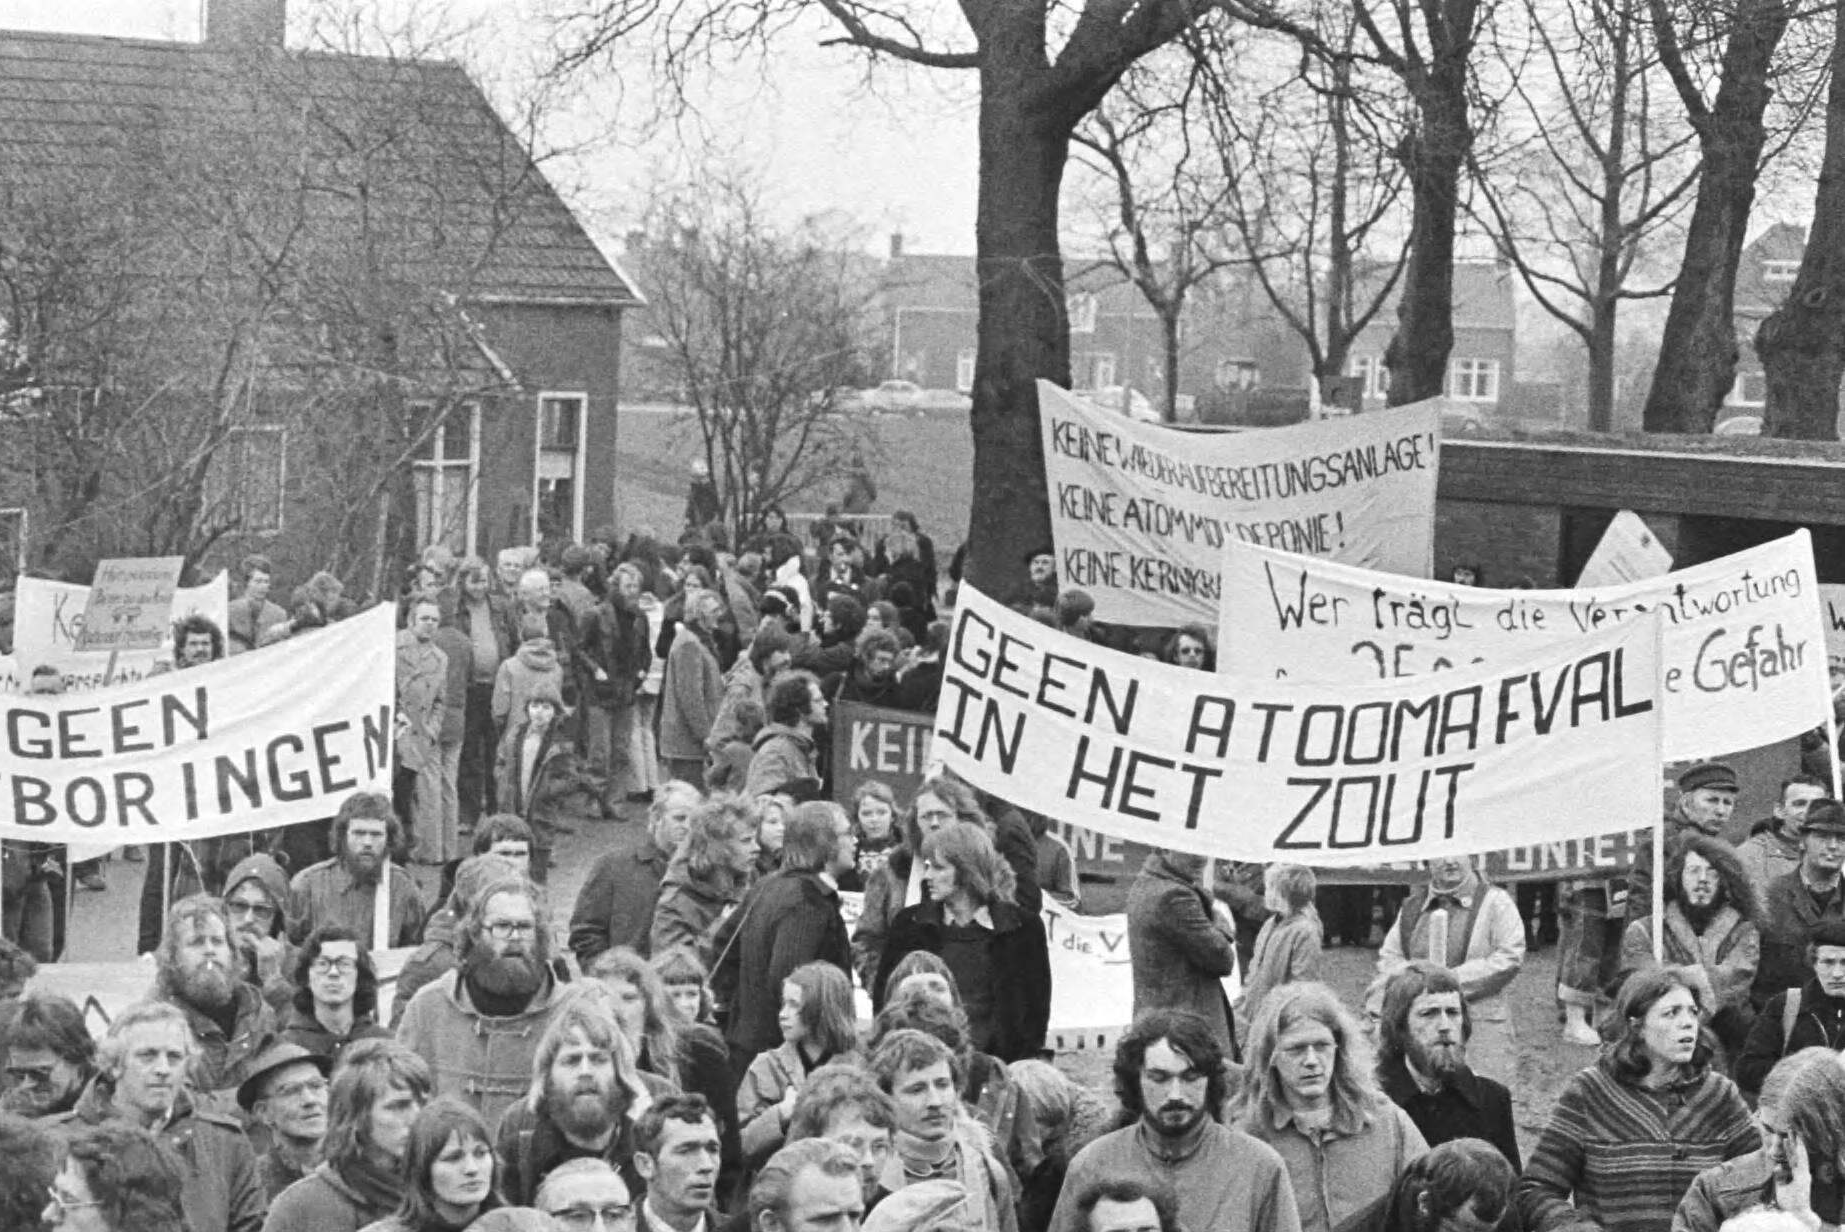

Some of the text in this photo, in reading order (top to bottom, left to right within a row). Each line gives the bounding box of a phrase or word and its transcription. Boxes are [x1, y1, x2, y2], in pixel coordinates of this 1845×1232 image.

[1052, 417, 1115, 467] KEINE
[1057, 481, 1118, 527] KEINE
[1064, 547, 1122, 589] KEINE
[1264, 561, 1349, 632] Wer
[1496, 598, 1546, 631] die
[953, 607, 1139, 736] GEEN
[1693, 624, 1807, 693] Gefahr
[7, 686, 208, 760] GEEN
[938, 675, 1475, 850] IN HET ZOUT
